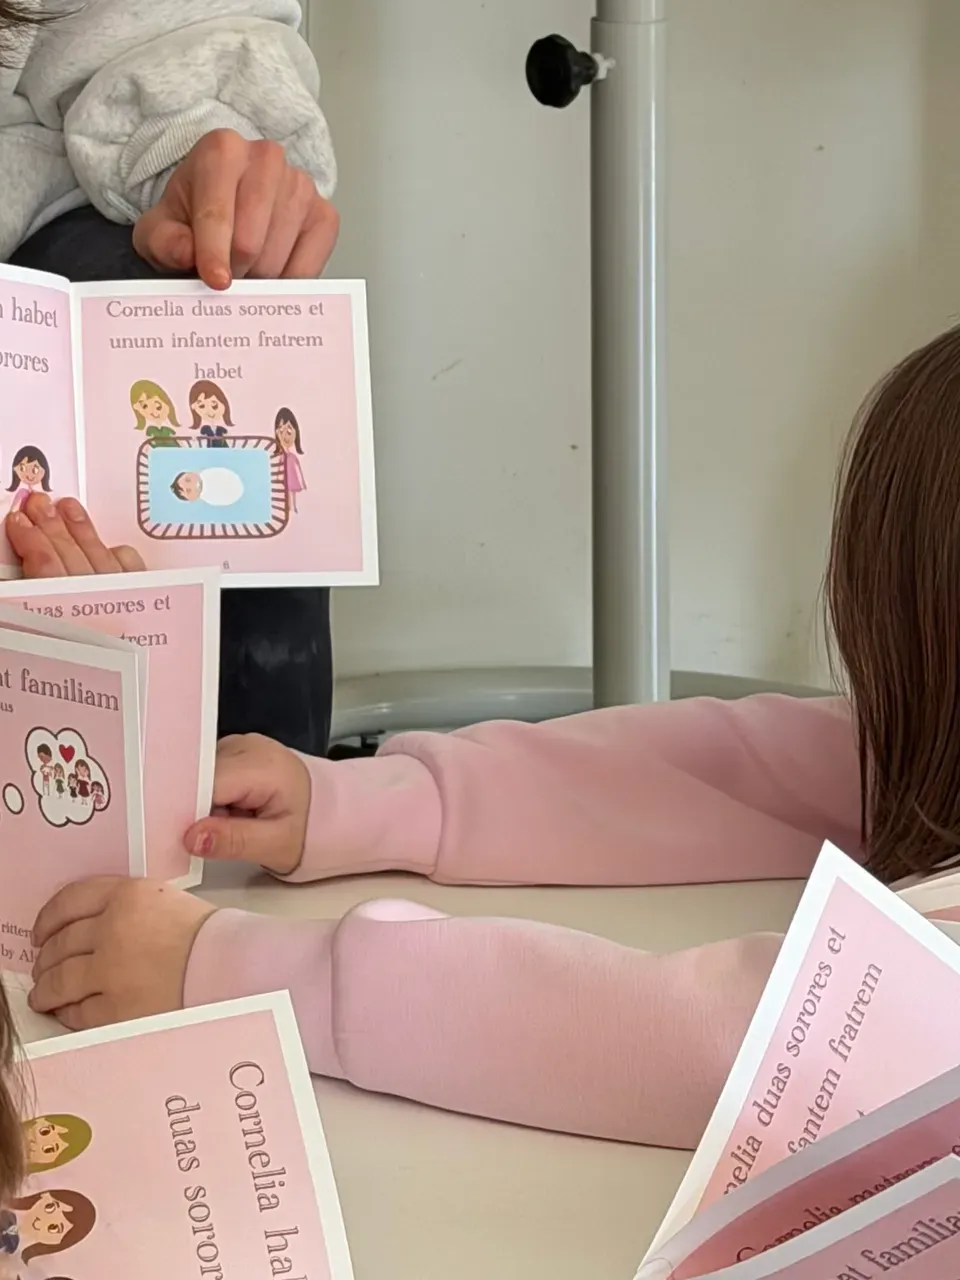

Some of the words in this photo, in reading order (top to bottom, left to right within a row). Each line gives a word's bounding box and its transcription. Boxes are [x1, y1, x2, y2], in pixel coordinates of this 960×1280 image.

[11, 296, 58, 329] habet
[106, 299, 185, 319] Cornelia
[191, 299, 233, 318] duas
[238, 302, 302, 318] sorores
[308, 300, 325, 317] et
[109, 333, 164, 349] unum
[171, 331, 251, 349] infantem
[258, 331, 324, 349] fratrem
[193, 362, 244, 381] habet
[71, 598, 146, 618] sorores
[154, 594, 171, 611] et
[20, 668, 121, 712] familiam
[1, 943, 15, 960] by
[751, 1061, 792, 1128] duas
[785, 959, 833, 1059] sorores
[826, 924, 847, 956] et
[827, 962, 883, 1063] fratrem
[164, 1094, 202, 1173] duas
[229, 1060, 287, 1213] Cornelia
[861, 1211, 960, 1272] familia
